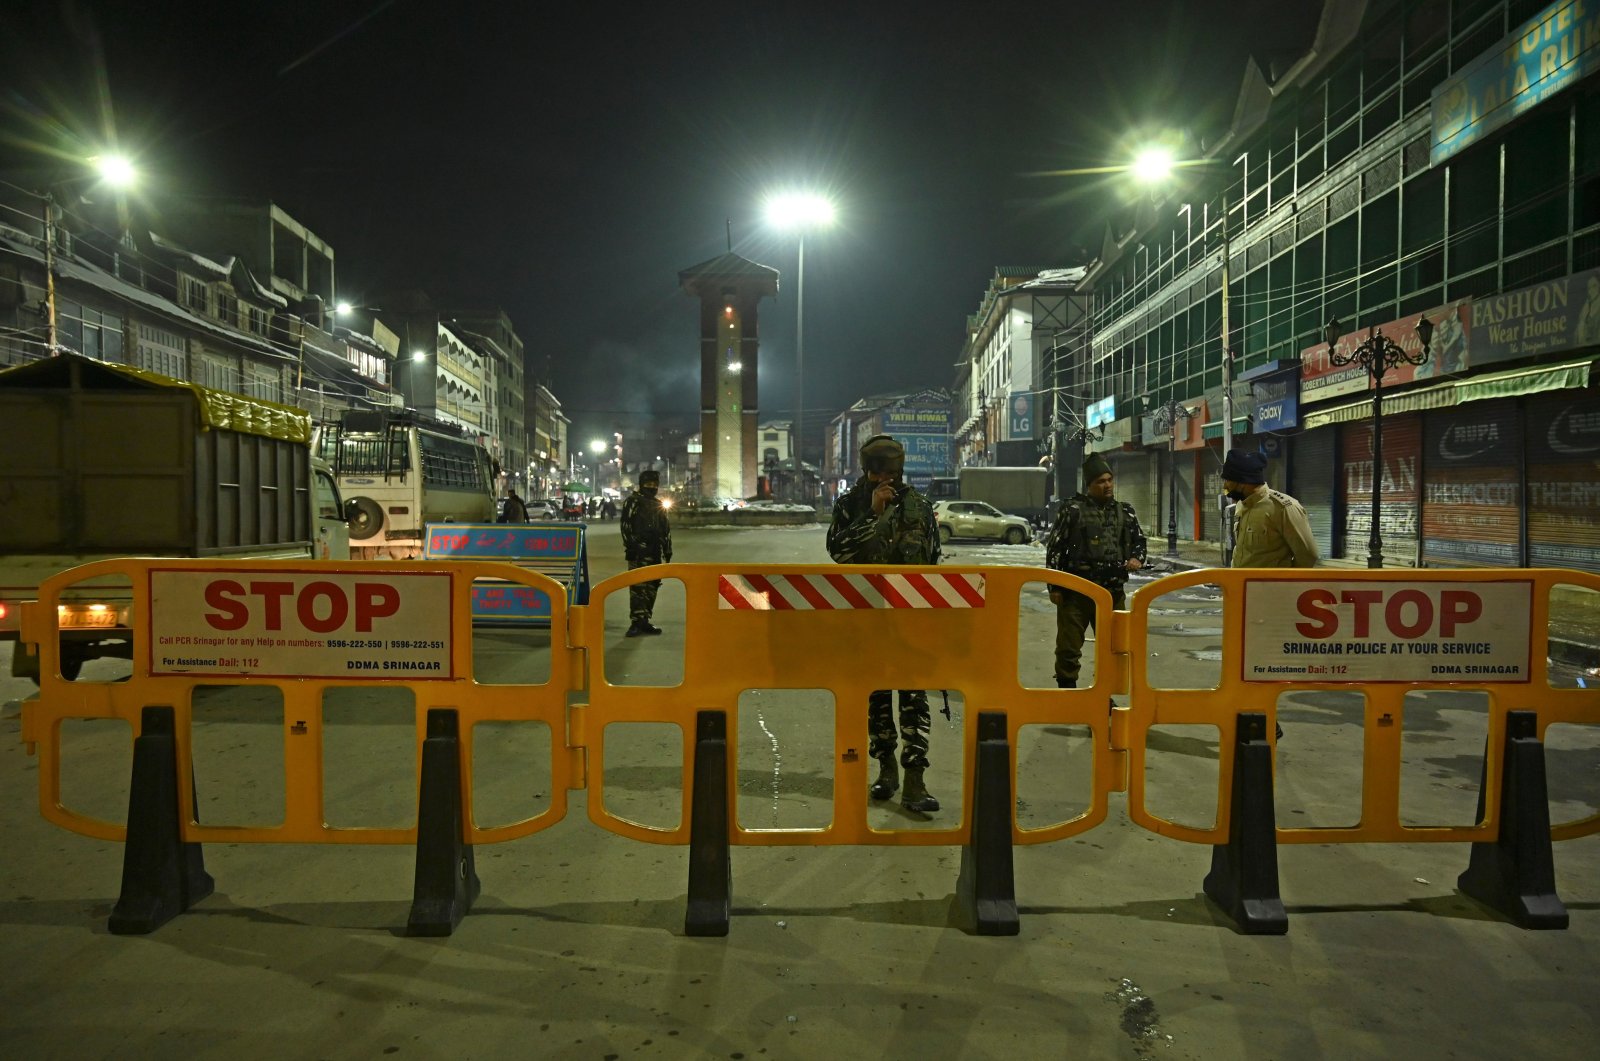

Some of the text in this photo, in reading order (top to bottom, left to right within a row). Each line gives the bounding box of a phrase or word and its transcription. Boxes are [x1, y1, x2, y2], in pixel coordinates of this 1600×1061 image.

[1504, 0, 1585, 67] HOTEL
[1472, 280, 1569, 328] FASHION
[1489, 315, 1567, 345] Wear House
[1302, 376, 1326, 391] ROBERTA
[1326, 372, 1346, 386] WATCH
[1346, 366, 1367, 379] HOUSE
[916, 413, 947, 422] NIWAS
[1258, 404, 1283, 421] Galaxy
[1013, 418, 1029, 432] LG
[1454, 423, 1498, 442] RUPA
[1344, 457, 1416, 494] TITAN
[1346, 509, 1416, 533] fasrack
[431, 535, 470, 551] STOP
[204, 579, 401, 633] STOP
[1295, 588, 1483, 639] STOP
[159, 636, 174, 645] Call
[175, 636, 191, 645] PCR
[193, 636, 226, 647] Srinagar
[227, 637, 238, 646] for
[240, 638, 255, 647] any
[257, 637, 275, 648] Help
[288, 638, 325, 648] numbers:
[327, 640, 382, 648] 9596-222-550
[391, 640, 444, 649] 9596-222-551
[1283, 642, 1491, 654] SRINAGAR POLICE AT YOUR SERVICE
[163, 657, 259, 667] For Assistance Dail: 112
[347, 660, 441, 670] DDMA SRINAGAR
[1254, 665, 1347, 674] For Assistance Dail: 112
[1431, 665, 1519, 674] DDMA SRINAGAR
